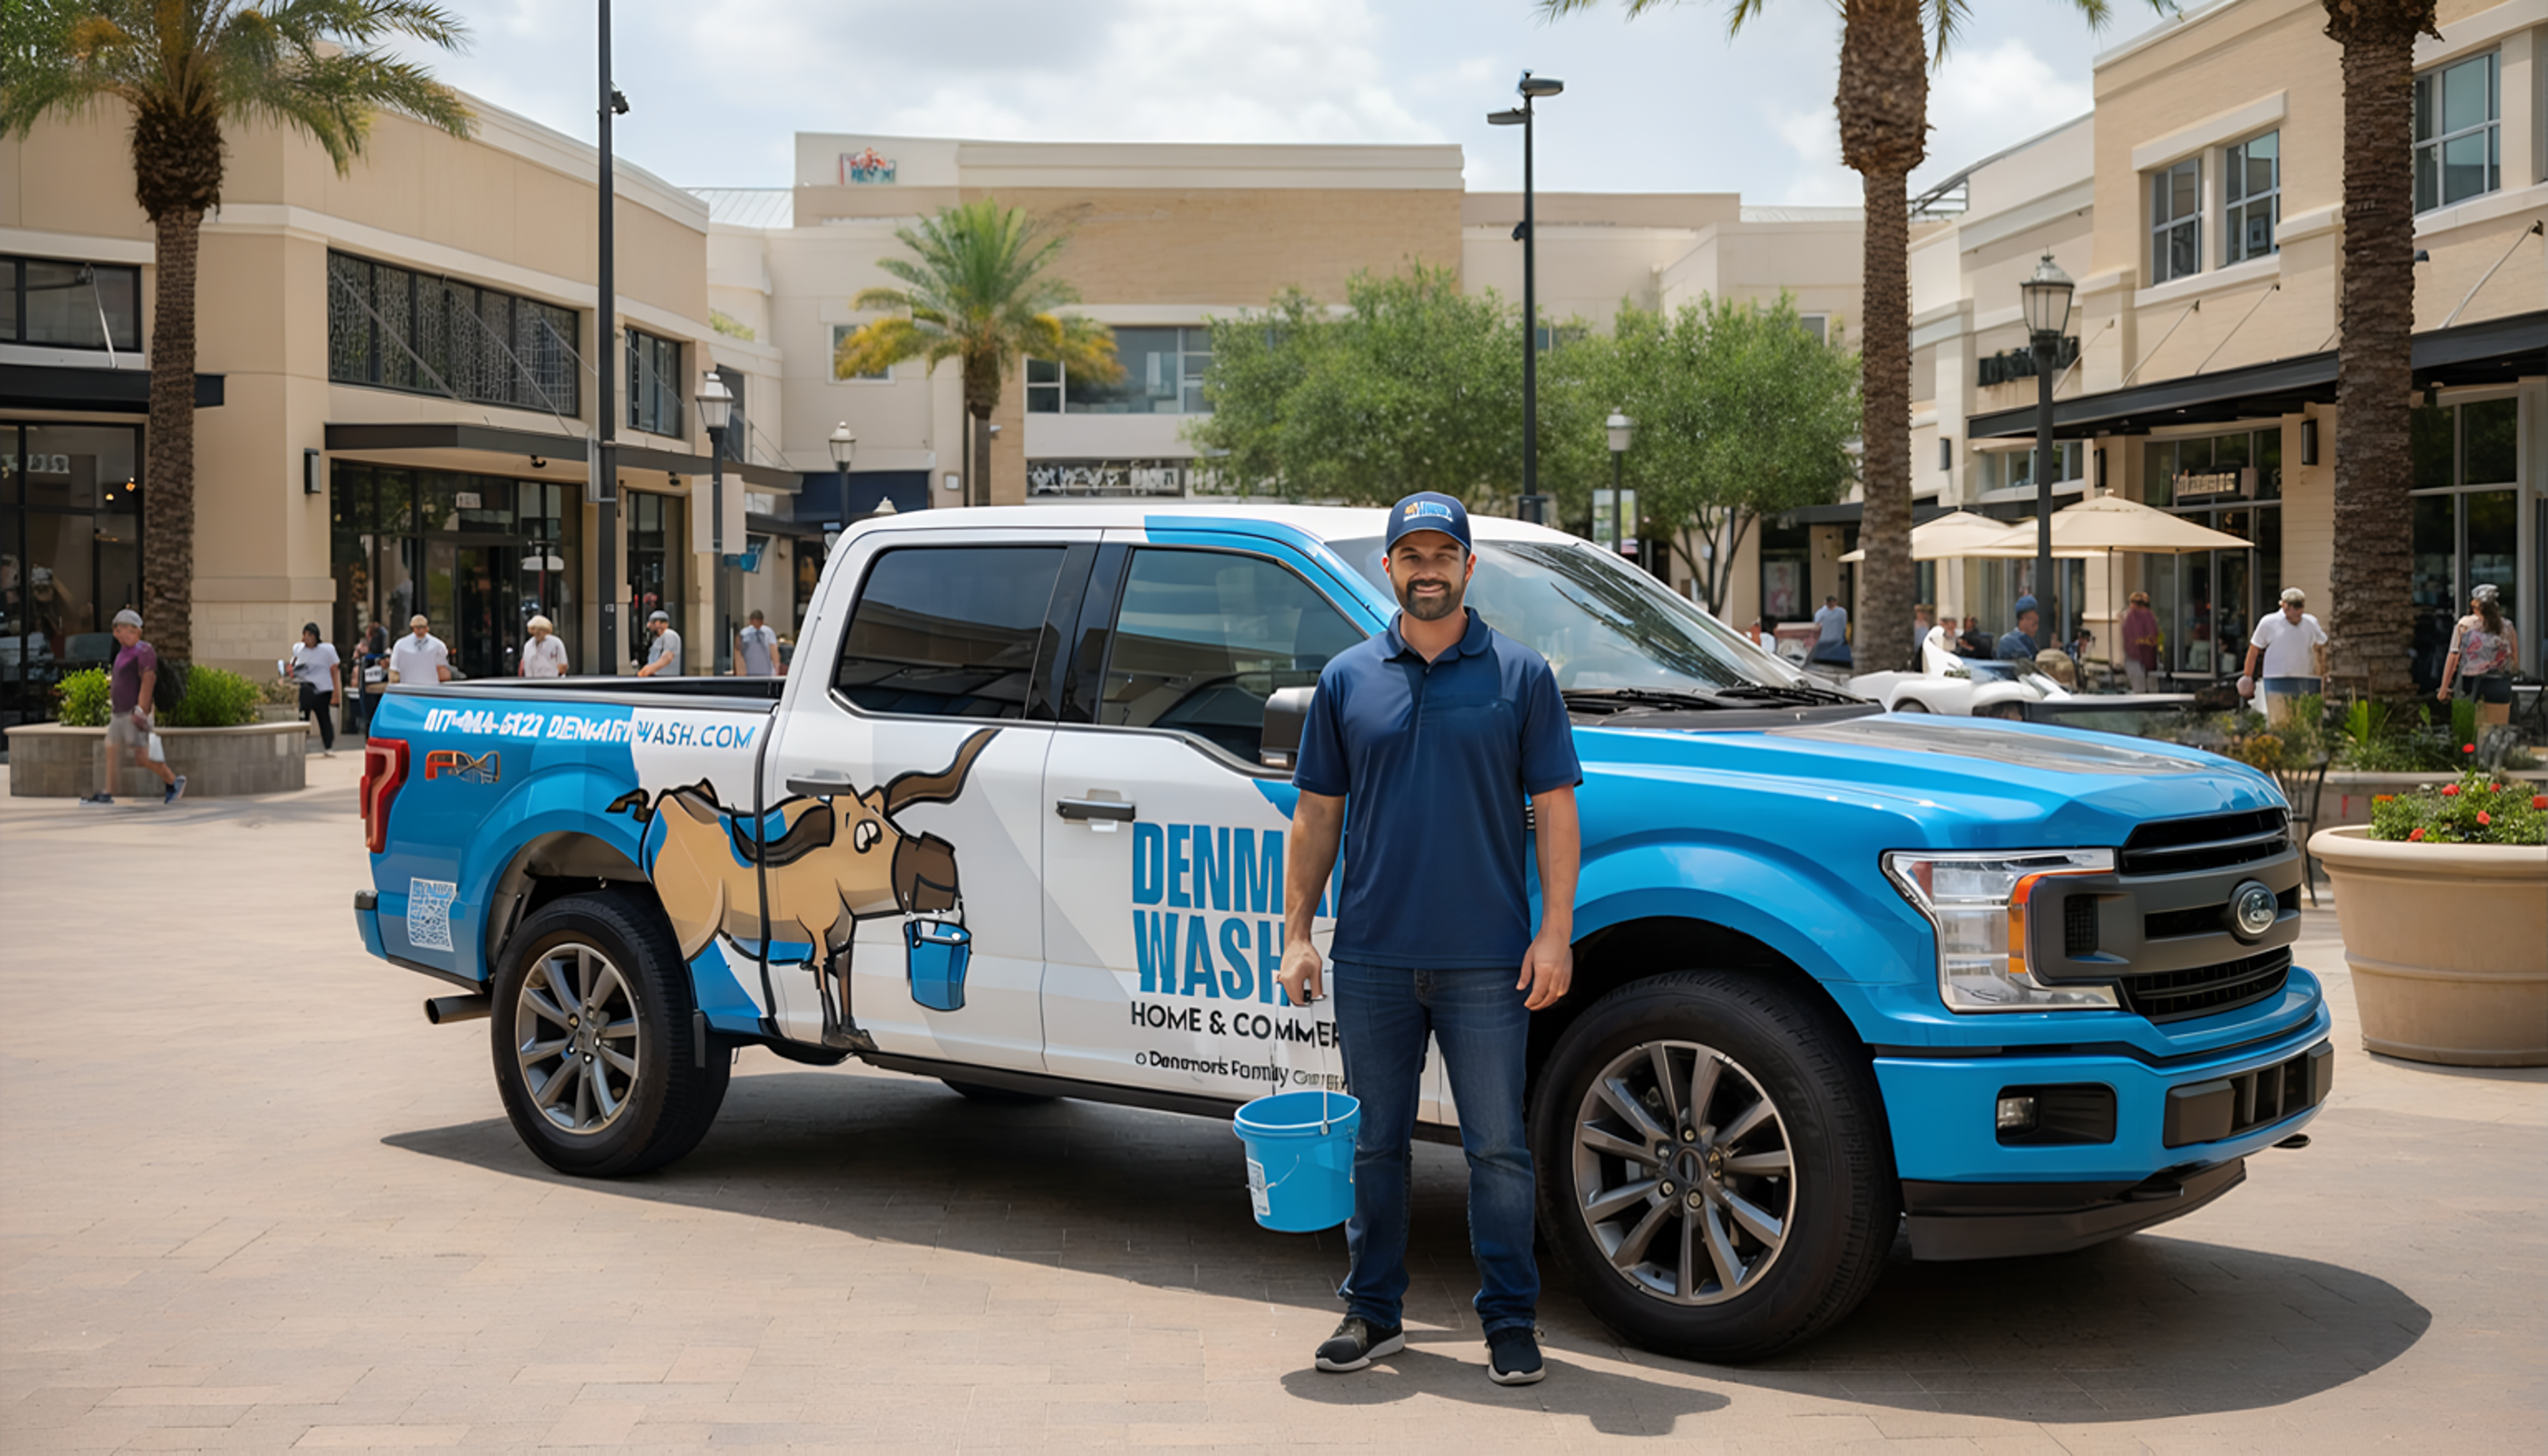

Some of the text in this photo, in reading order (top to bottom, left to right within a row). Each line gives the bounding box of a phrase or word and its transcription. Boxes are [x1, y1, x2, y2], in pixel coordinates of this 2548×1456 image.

[1132, 822, 1346, 919] DENM
[1132, 909, 1291, 1007] WASH
[1131, 1001, 1201, 1032] HOME
[1209, 1010, 1226, 1036] &
